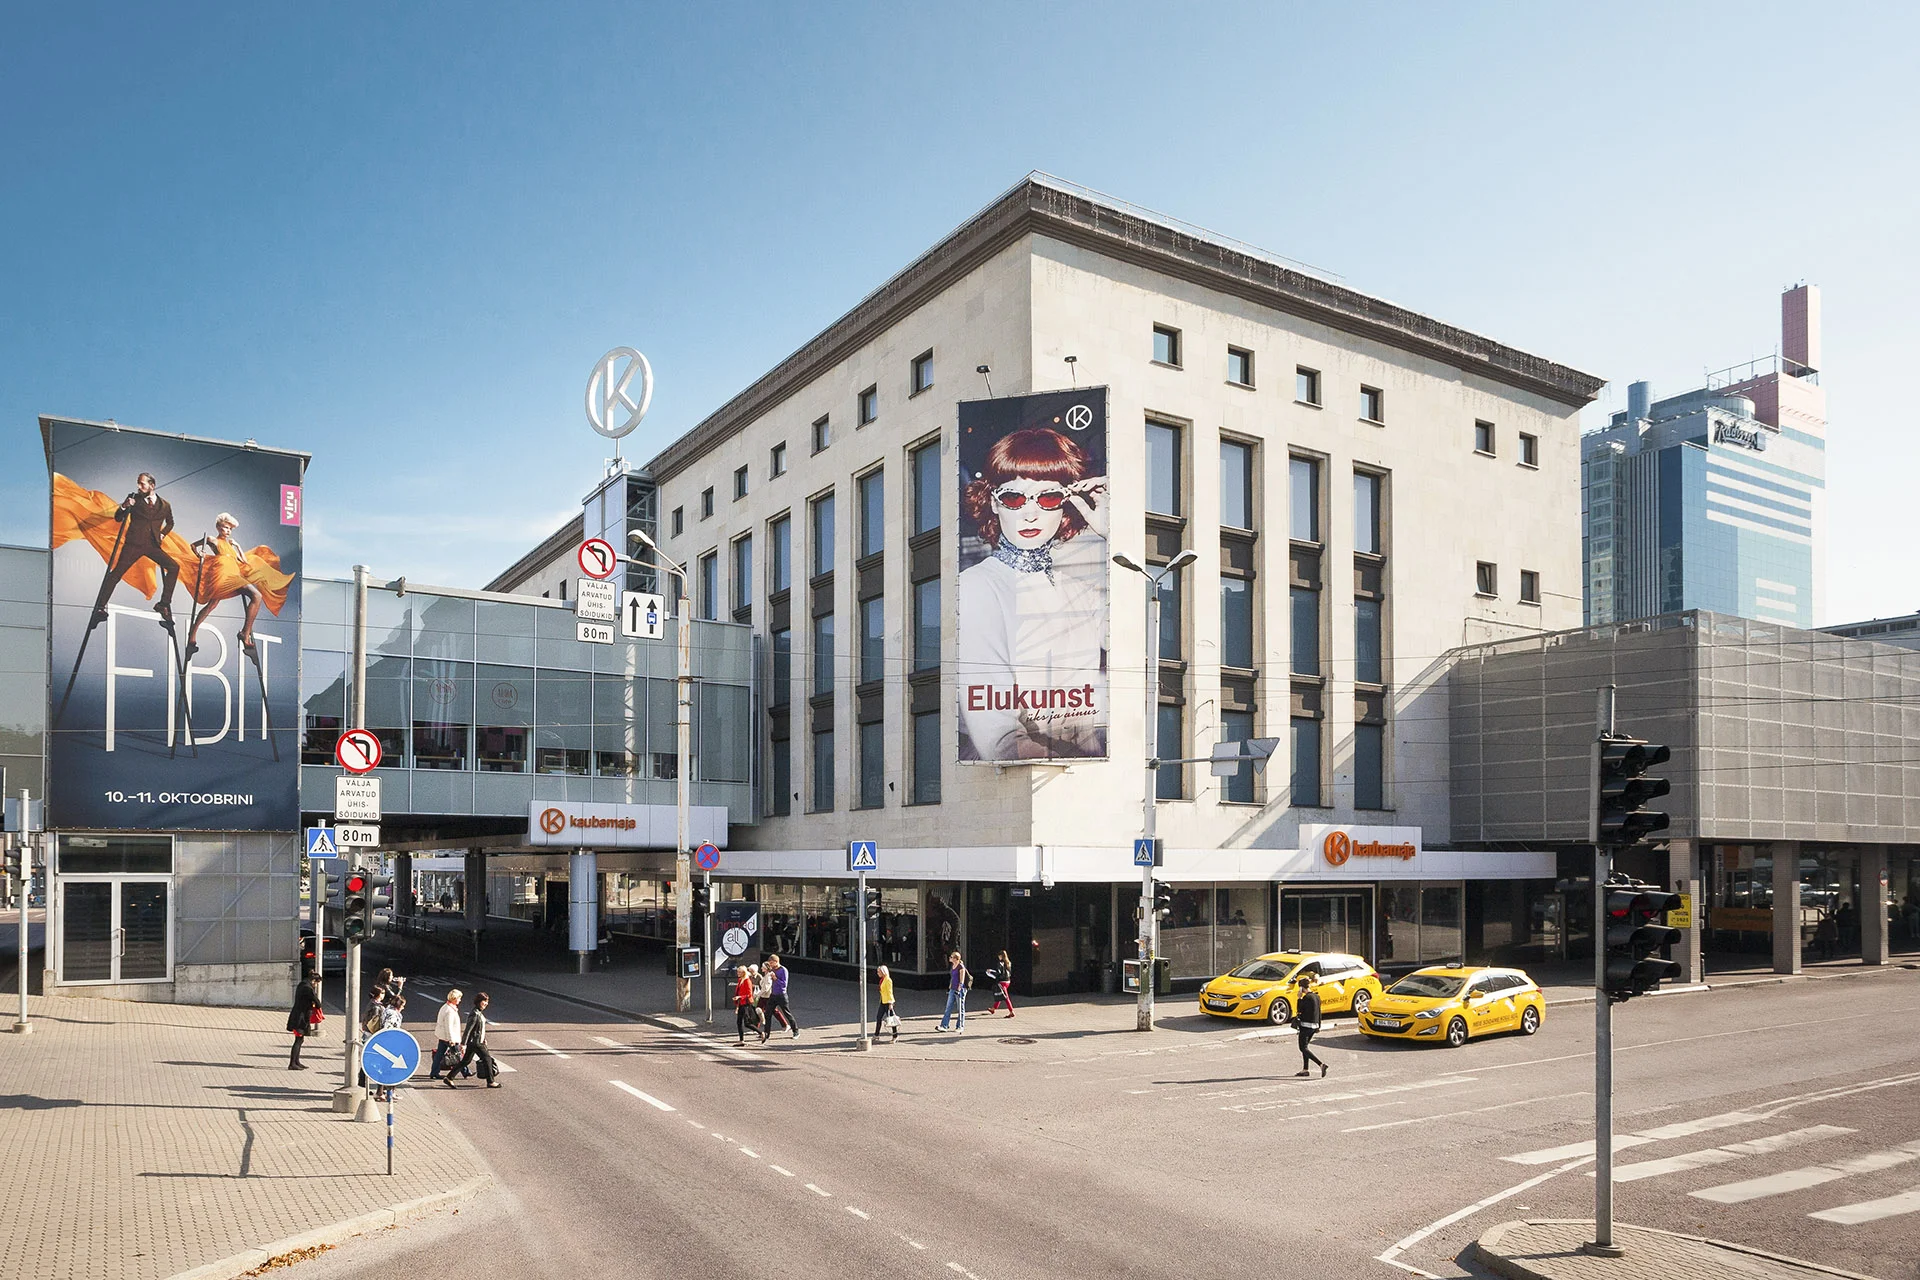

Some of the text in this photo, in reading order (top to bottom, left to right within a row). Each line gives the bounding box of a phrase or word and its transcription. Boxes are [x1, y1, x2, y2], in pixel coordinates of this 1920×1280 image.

[285, 491, 295, 520] viru
[581, 591, 613, 600] ARVATUD
[579, 610, 613, 619] SÕIDUKID
[967, 684, 1095, 711] Elukunst
[1026, 708, 1100, 724] üks ja ainus
[158, 792, 253, 805] OKTOOBRINI
[340, 790, 377, 798] ARVATUD
[339, 810, 377, 818] SÕIDUKID
[569, 815, 636, 831] kaubamaja
[1352, 840, 1416, 861] kaubamaja
